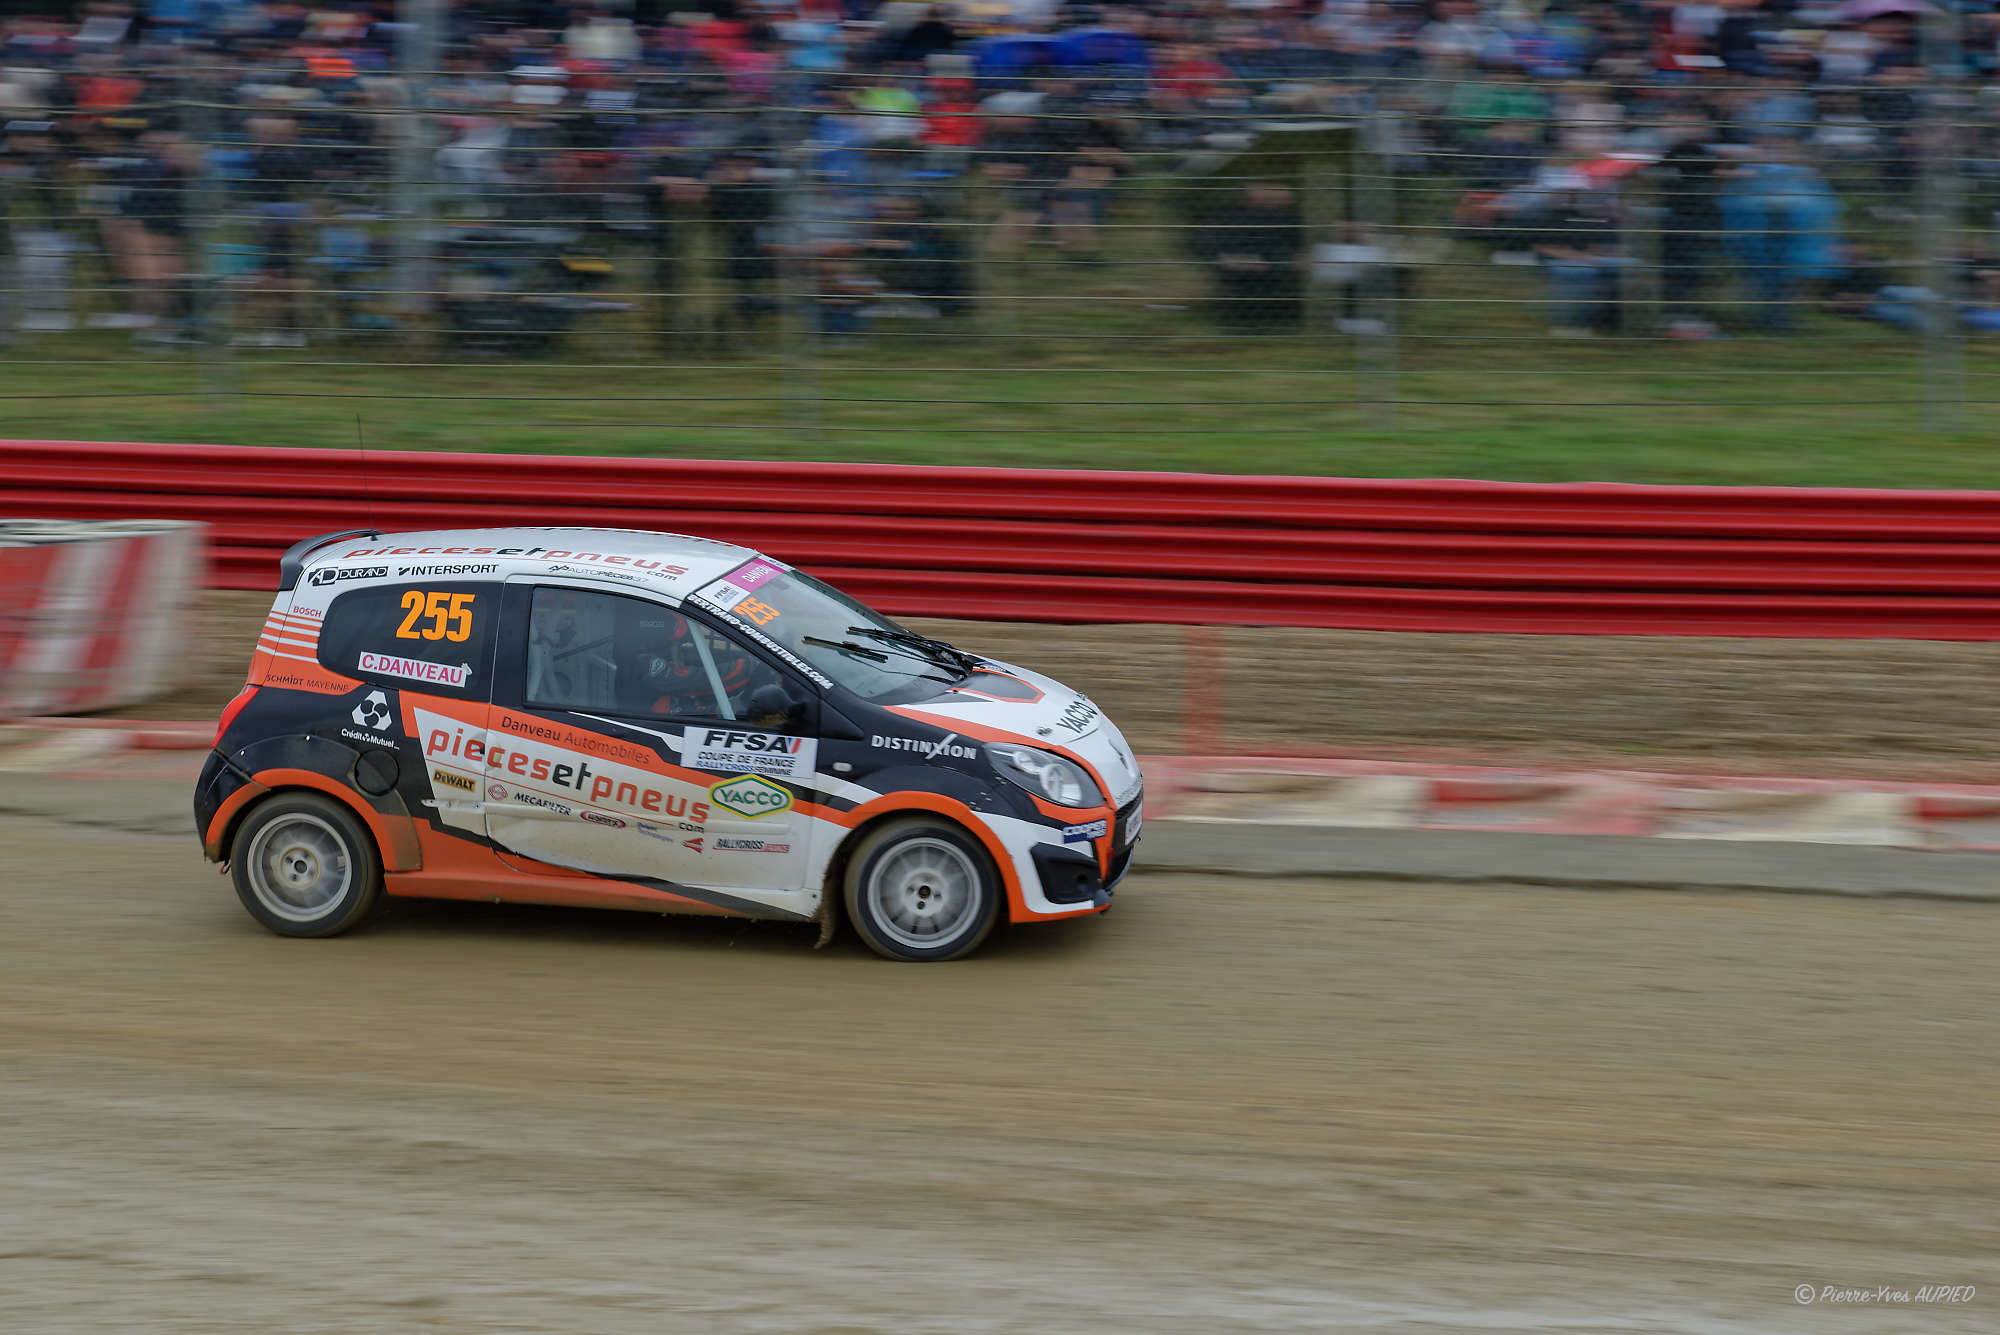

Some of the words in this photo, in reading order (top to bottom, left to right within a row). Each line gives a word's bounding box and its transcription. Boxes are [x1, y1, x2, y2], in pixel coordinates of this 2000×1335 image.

[339, 567, 388, 580] DURAND
[411, 564, 498, 576] INTERSPORT
[293, 605, 323, 618] BOSCH
[396, 590, 475, 642] 255
[732, 596, 781, 626] 255
[362, 654, 463, 684] C.DANVEAU
[306, 679, 349, 692] MAYENNE
[1056, 700, 1098, 734] YACCO
[341, 728, 363, 741] Crédit
[370, 735, 395, 748] Mutuel
[502, 716, 561, 741] Danveau
[564, 731, 650, 764] Automobiles
[703, 730, 789, 753] FFSA
[871, 734, 977, 760] DISTINXION
[698, 751, 734, 761] COUPE
[737, 756, 752, 764] DE
[753, 756, 796, 768] FRANCE
[426, 728, 710, 824] piecesetpneus
[513, 792, 573, 816] MECAFILTER
[720, 789, 783, 806] YACCO
[679, 822, 705, 834] com
